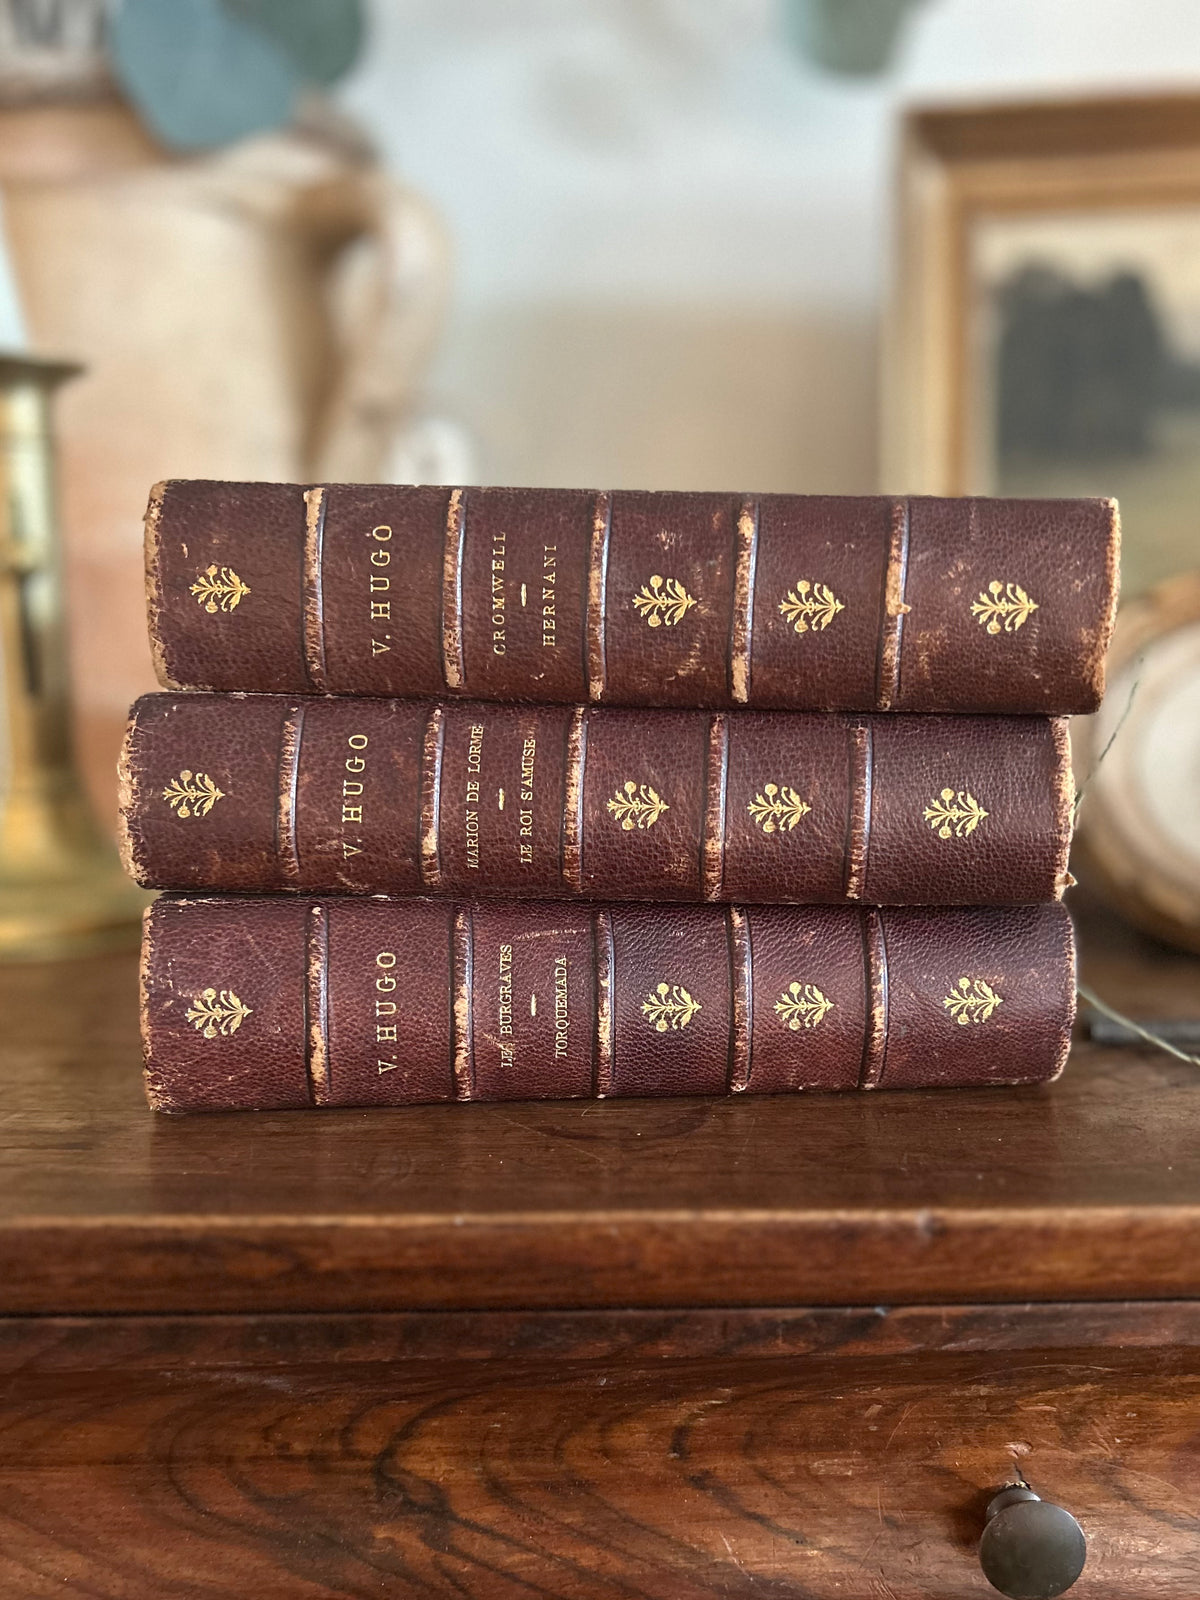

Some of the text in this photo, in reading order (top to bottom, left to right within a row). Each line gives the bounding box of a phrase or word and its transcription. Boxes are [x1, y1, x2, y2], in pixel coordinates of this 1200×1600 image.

[370, 525, 393, 656] V. HUGO
[492, 531, 506, 655] CROMWELL
[543, 545, 557, 646] HERNANI
[341, 734, 368, 860] V. HUGO
[466, 725, 485, 869] MARION DE LORME
[520, 739, 536, 864] LE ROI S'AMUSE
[376, 952, 398, 1075] V. HUGO
[500, 944, 513, 1035] BURGRAVES
[555, 954, 570, 1059] TORQUEMADA
